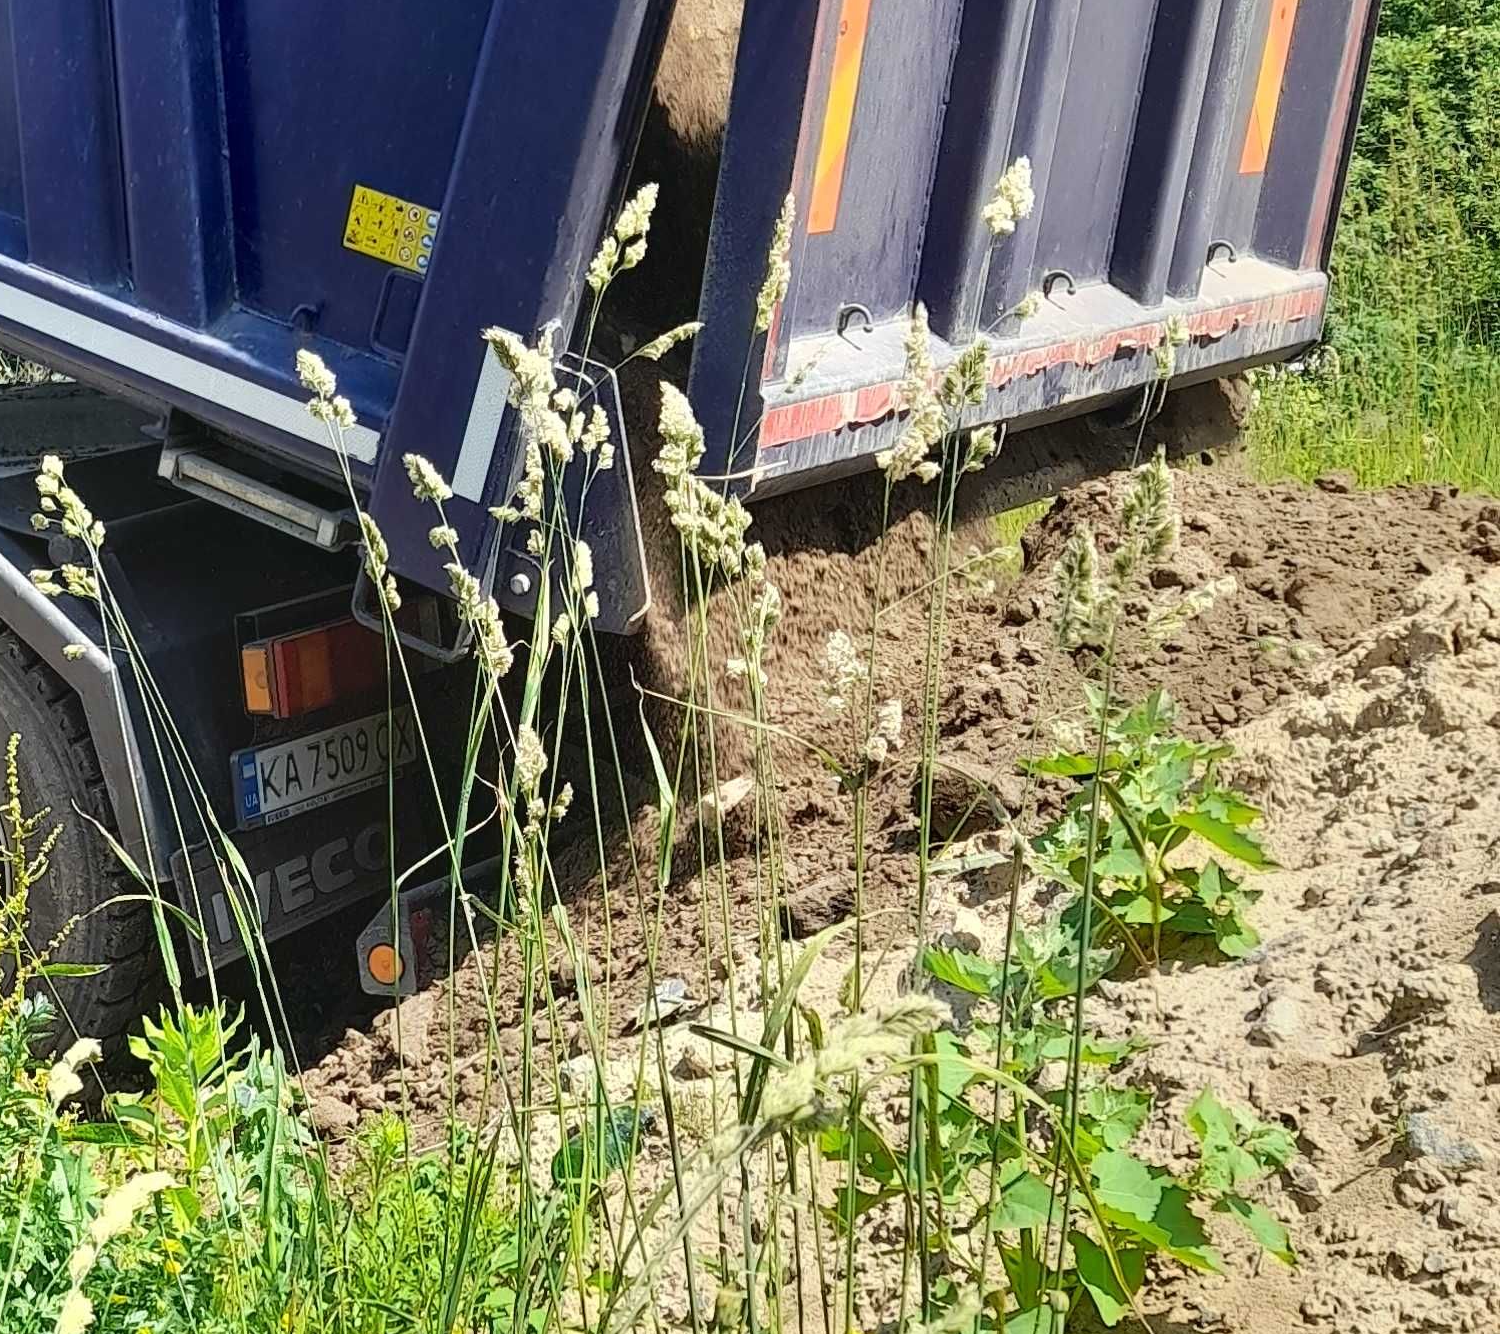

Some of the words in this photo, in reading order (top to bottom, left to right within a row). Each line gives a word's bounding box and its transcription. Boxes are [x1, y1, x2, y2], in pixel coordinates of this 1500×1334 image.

[260, 752, 302, 804] KA
[307, 728, 368, 787] 7509
[245, 792, 259, 809] UA
